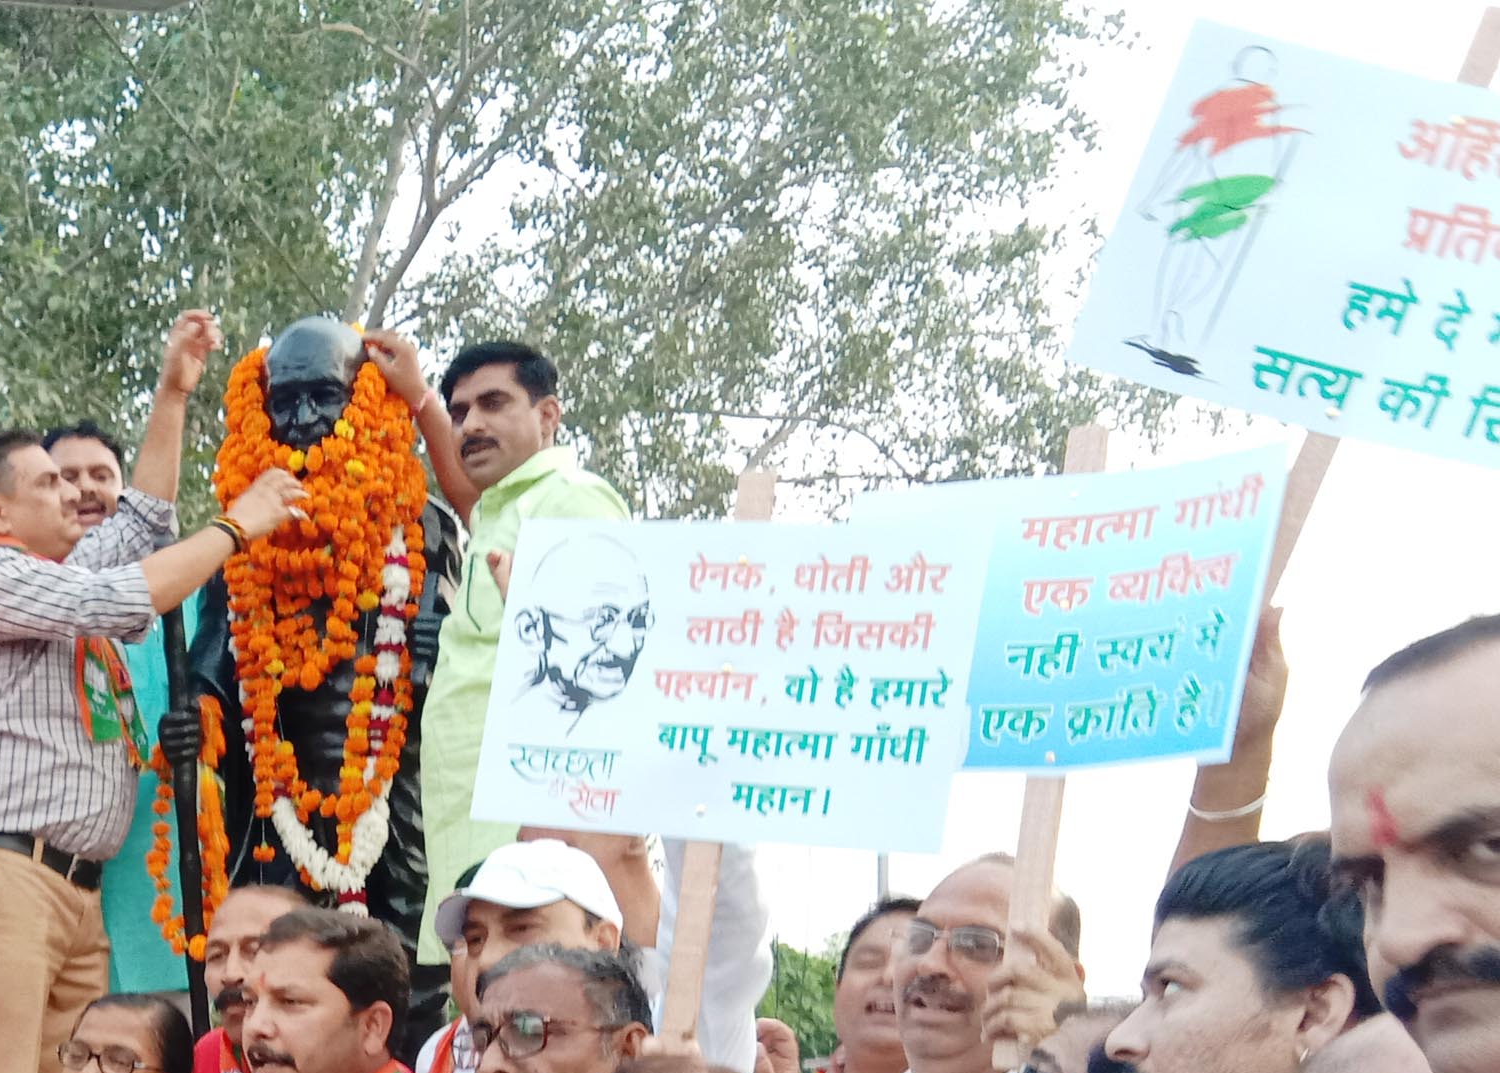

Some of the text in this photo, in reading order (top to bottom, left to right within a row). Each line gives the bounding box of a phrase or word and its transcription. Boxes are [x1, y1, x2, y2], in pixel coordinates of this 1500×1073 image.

[1252, 345, 1364, 411] सत्य
[1378, 373, 1451, 429] की
[1021, 504, 1160, 551] महात्मा
[794, 553, 872, 594] धोती
[884, 550, 952, 594] और
[1023, 577, 1094, 615] एक
[686, 606, 936, 652] लाठी है जिसकी
[785, 664, 822, 705] वो
[834, 664, 859, 710] है
[869, 667, 953, 711] हमारे
[658, 723, 718, 765] बापू
[726, 726, 839, 761] महात्मा
[980, 705, 1052, 742] एक
